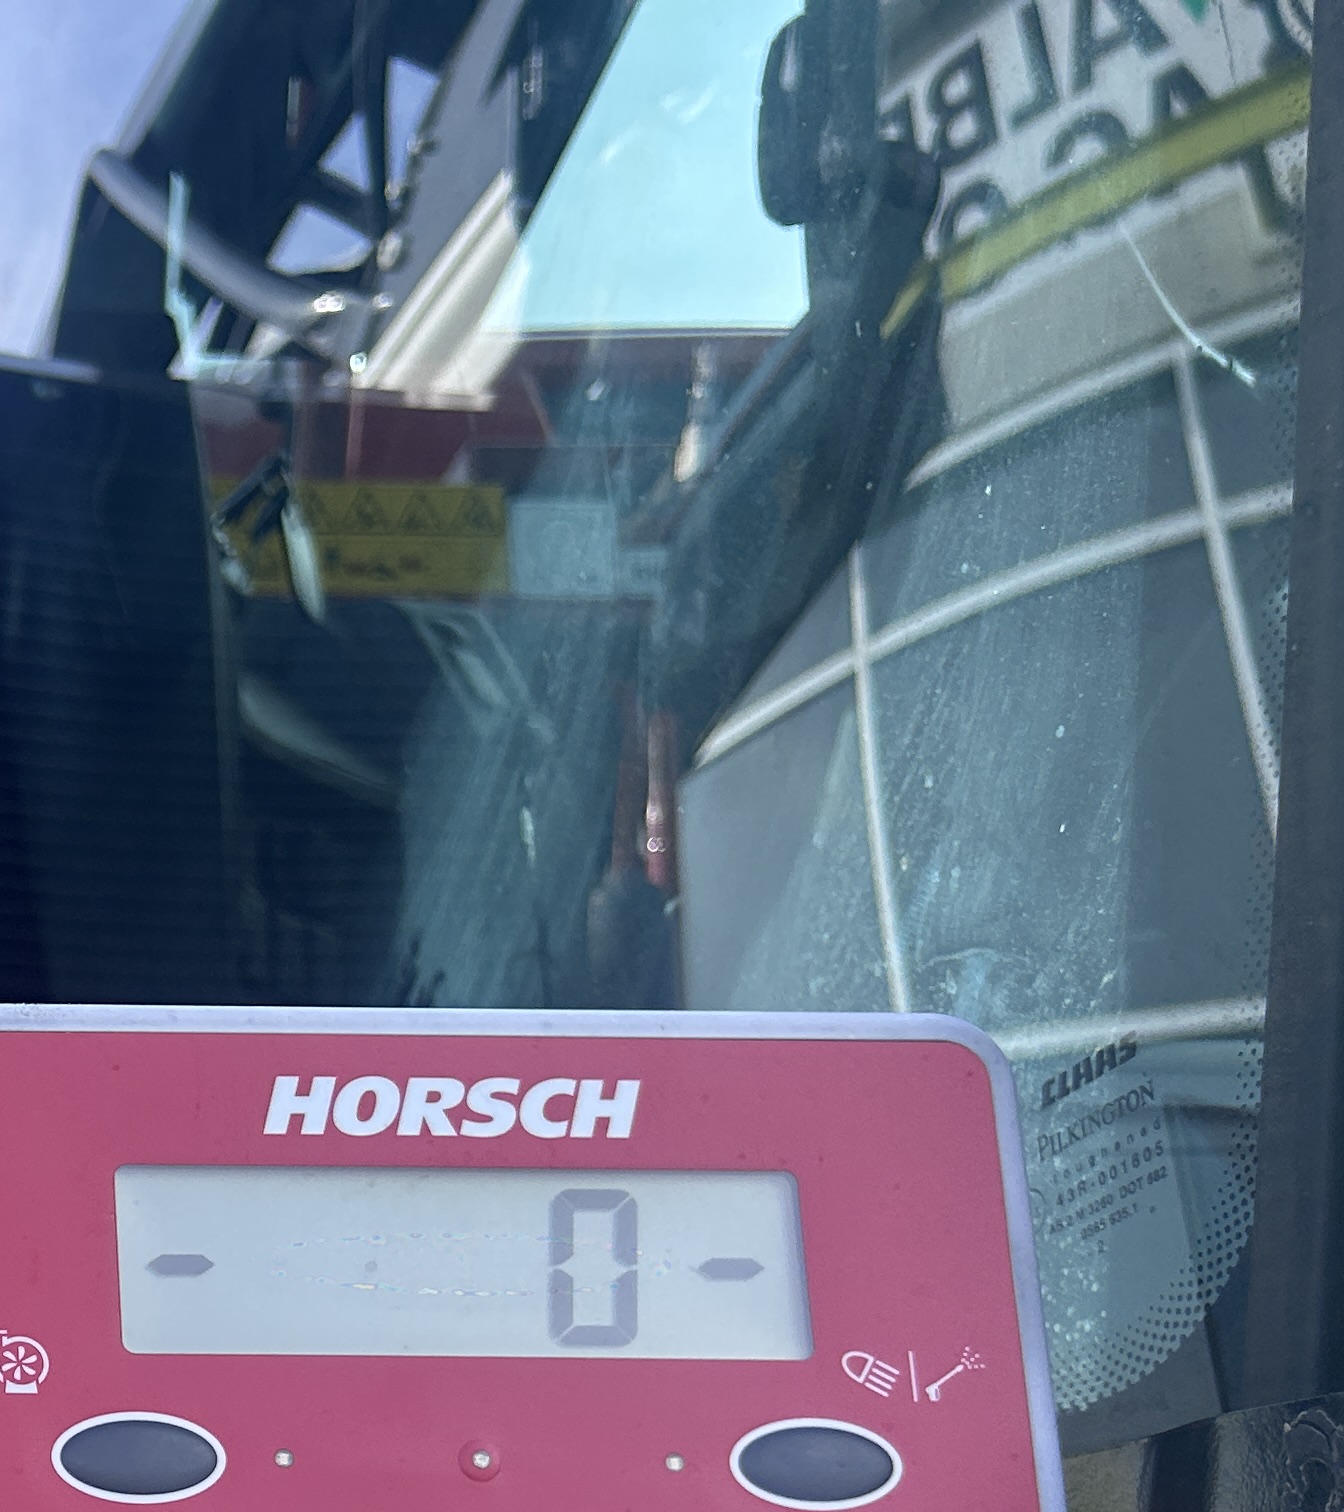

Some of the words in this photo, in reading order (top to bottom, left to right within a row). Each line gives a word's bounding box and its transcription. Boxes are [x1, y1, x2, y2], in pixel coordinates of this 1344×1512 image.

[263, 1075, 641, 1139] HORSCH
[1040, 1030, 1138, 1112] CLAAS
[1037, 1079, 1156, 1163] PILKINGTON
[548, 1188, 638, 1347] 0
